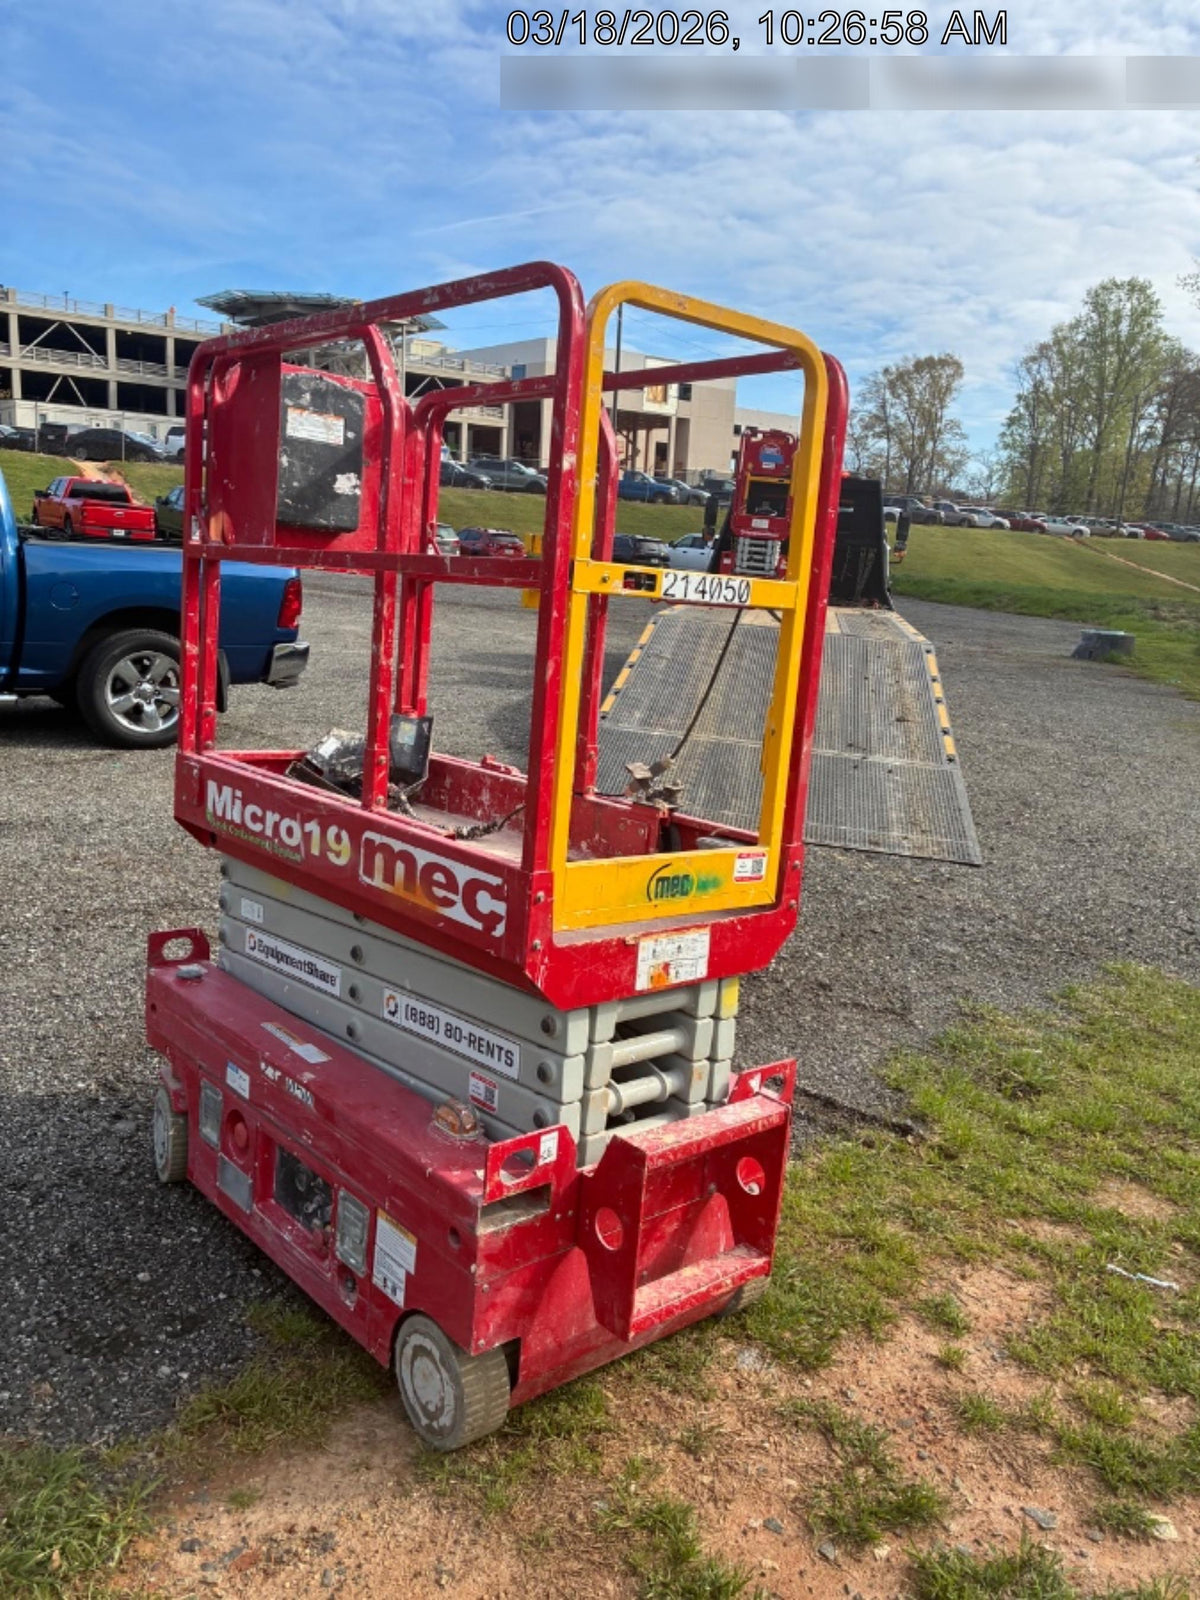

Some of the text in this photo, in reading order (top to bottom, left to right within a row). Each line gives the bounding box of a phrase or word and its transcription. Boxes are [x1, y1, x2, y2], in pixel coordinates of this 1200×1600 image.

[663, 572, 751, 604] 214050
[257, 937, 338, 987] EquipmentShare
[404, 1003, 515, 1068] (888) 80-RENTS
